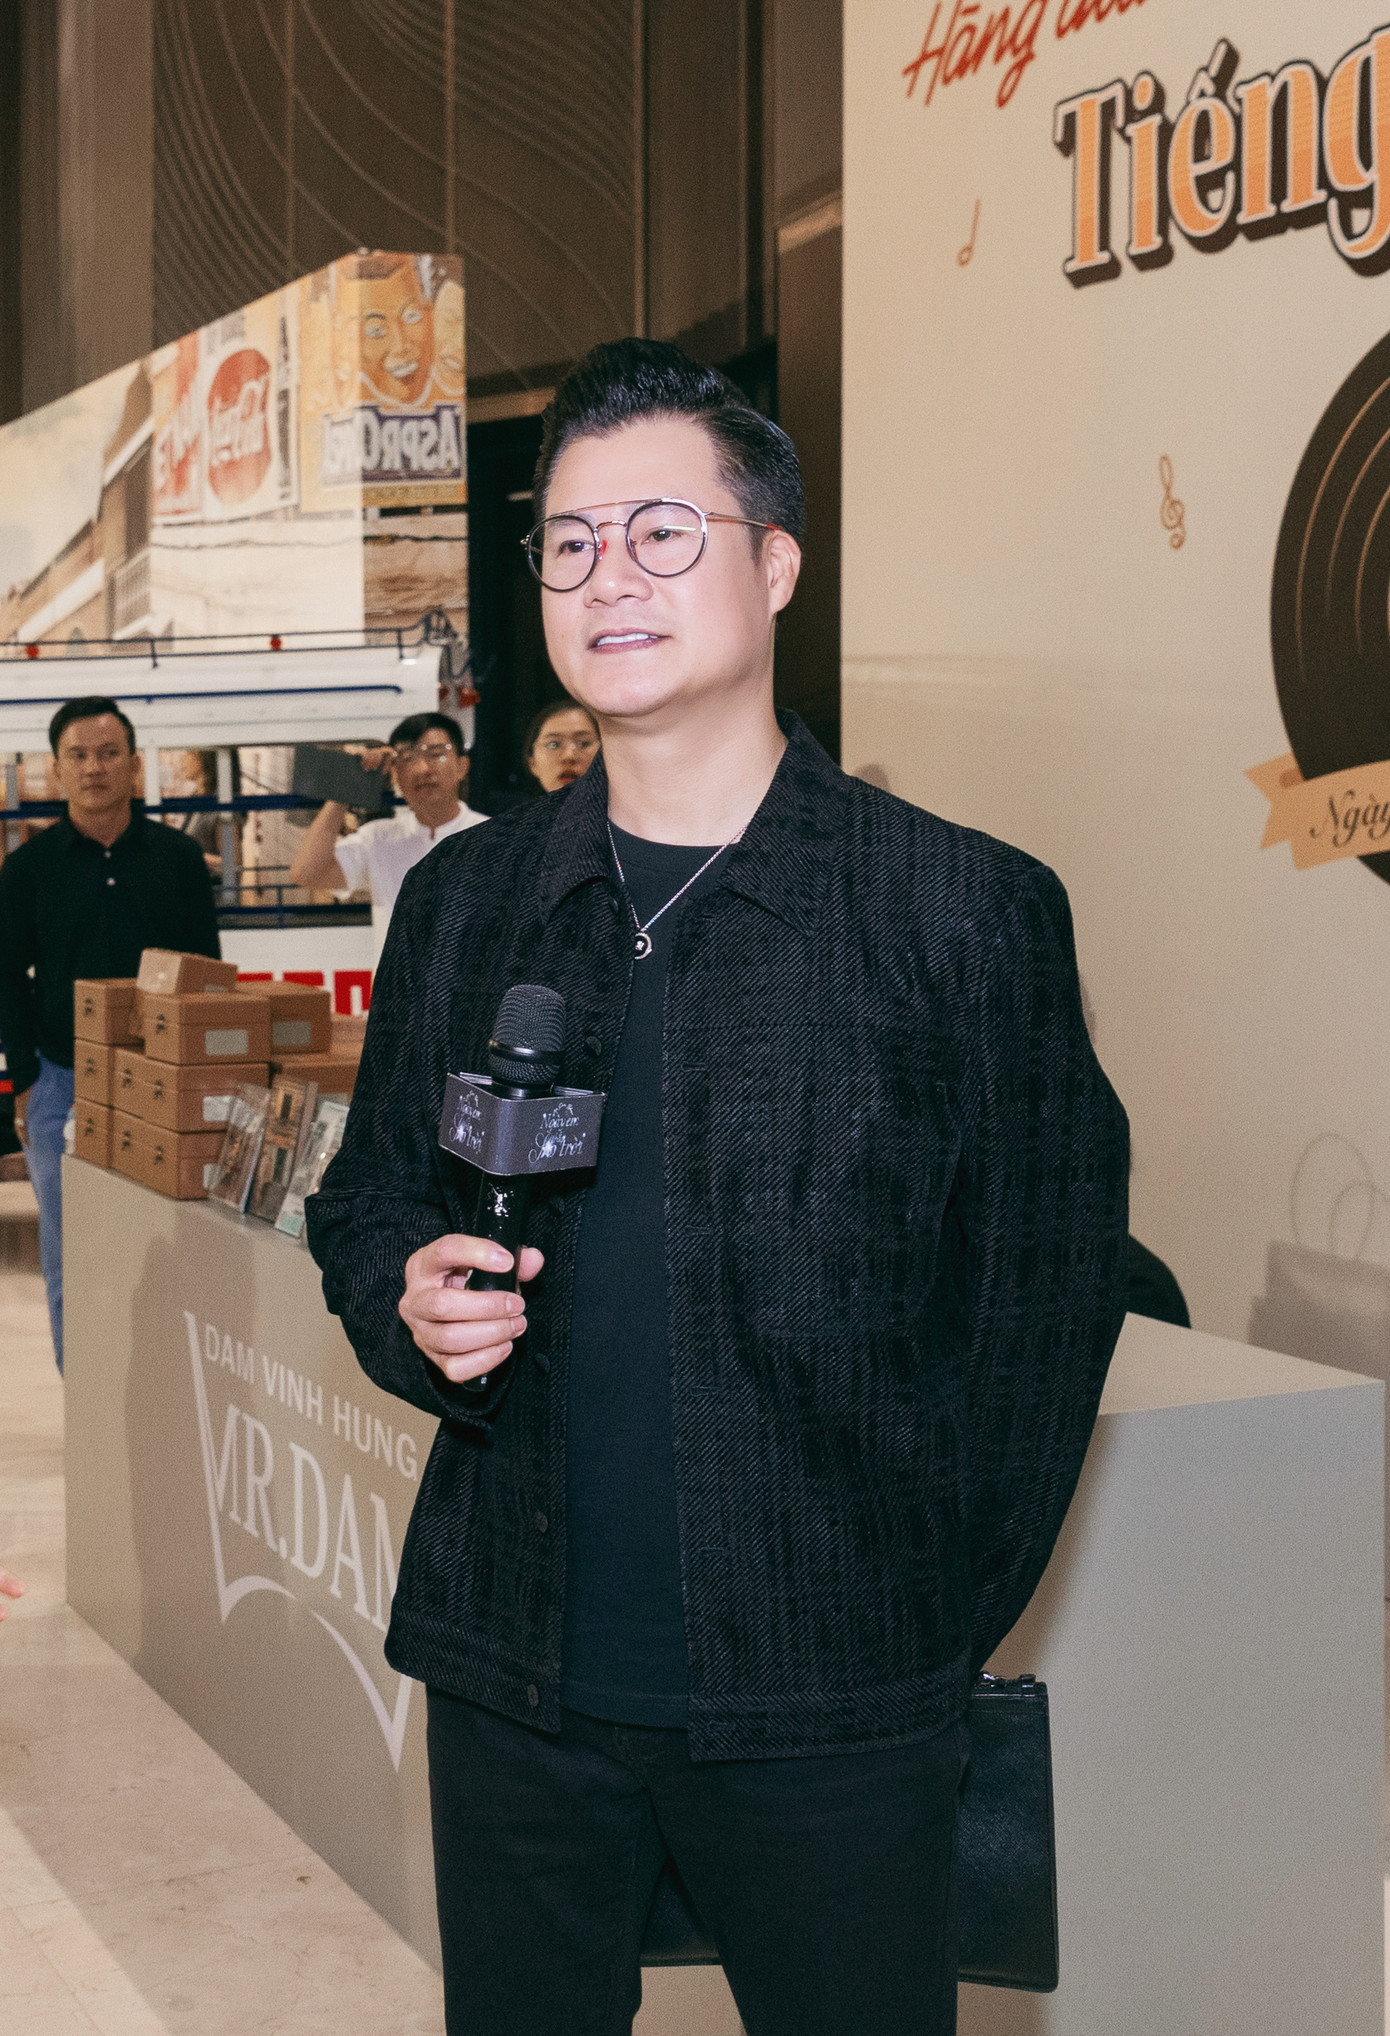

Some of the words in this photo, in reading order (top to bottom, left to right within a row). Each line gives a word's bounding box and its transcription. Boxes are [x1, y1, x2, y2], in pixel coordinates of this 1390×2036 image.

[1053, 24, 1390, 289] Tiếng
[205, 1323, 254, 1384] DAM
[262, 1354, 324, 1426] VINH
[333, 1394, 418, 1481] HUNG
